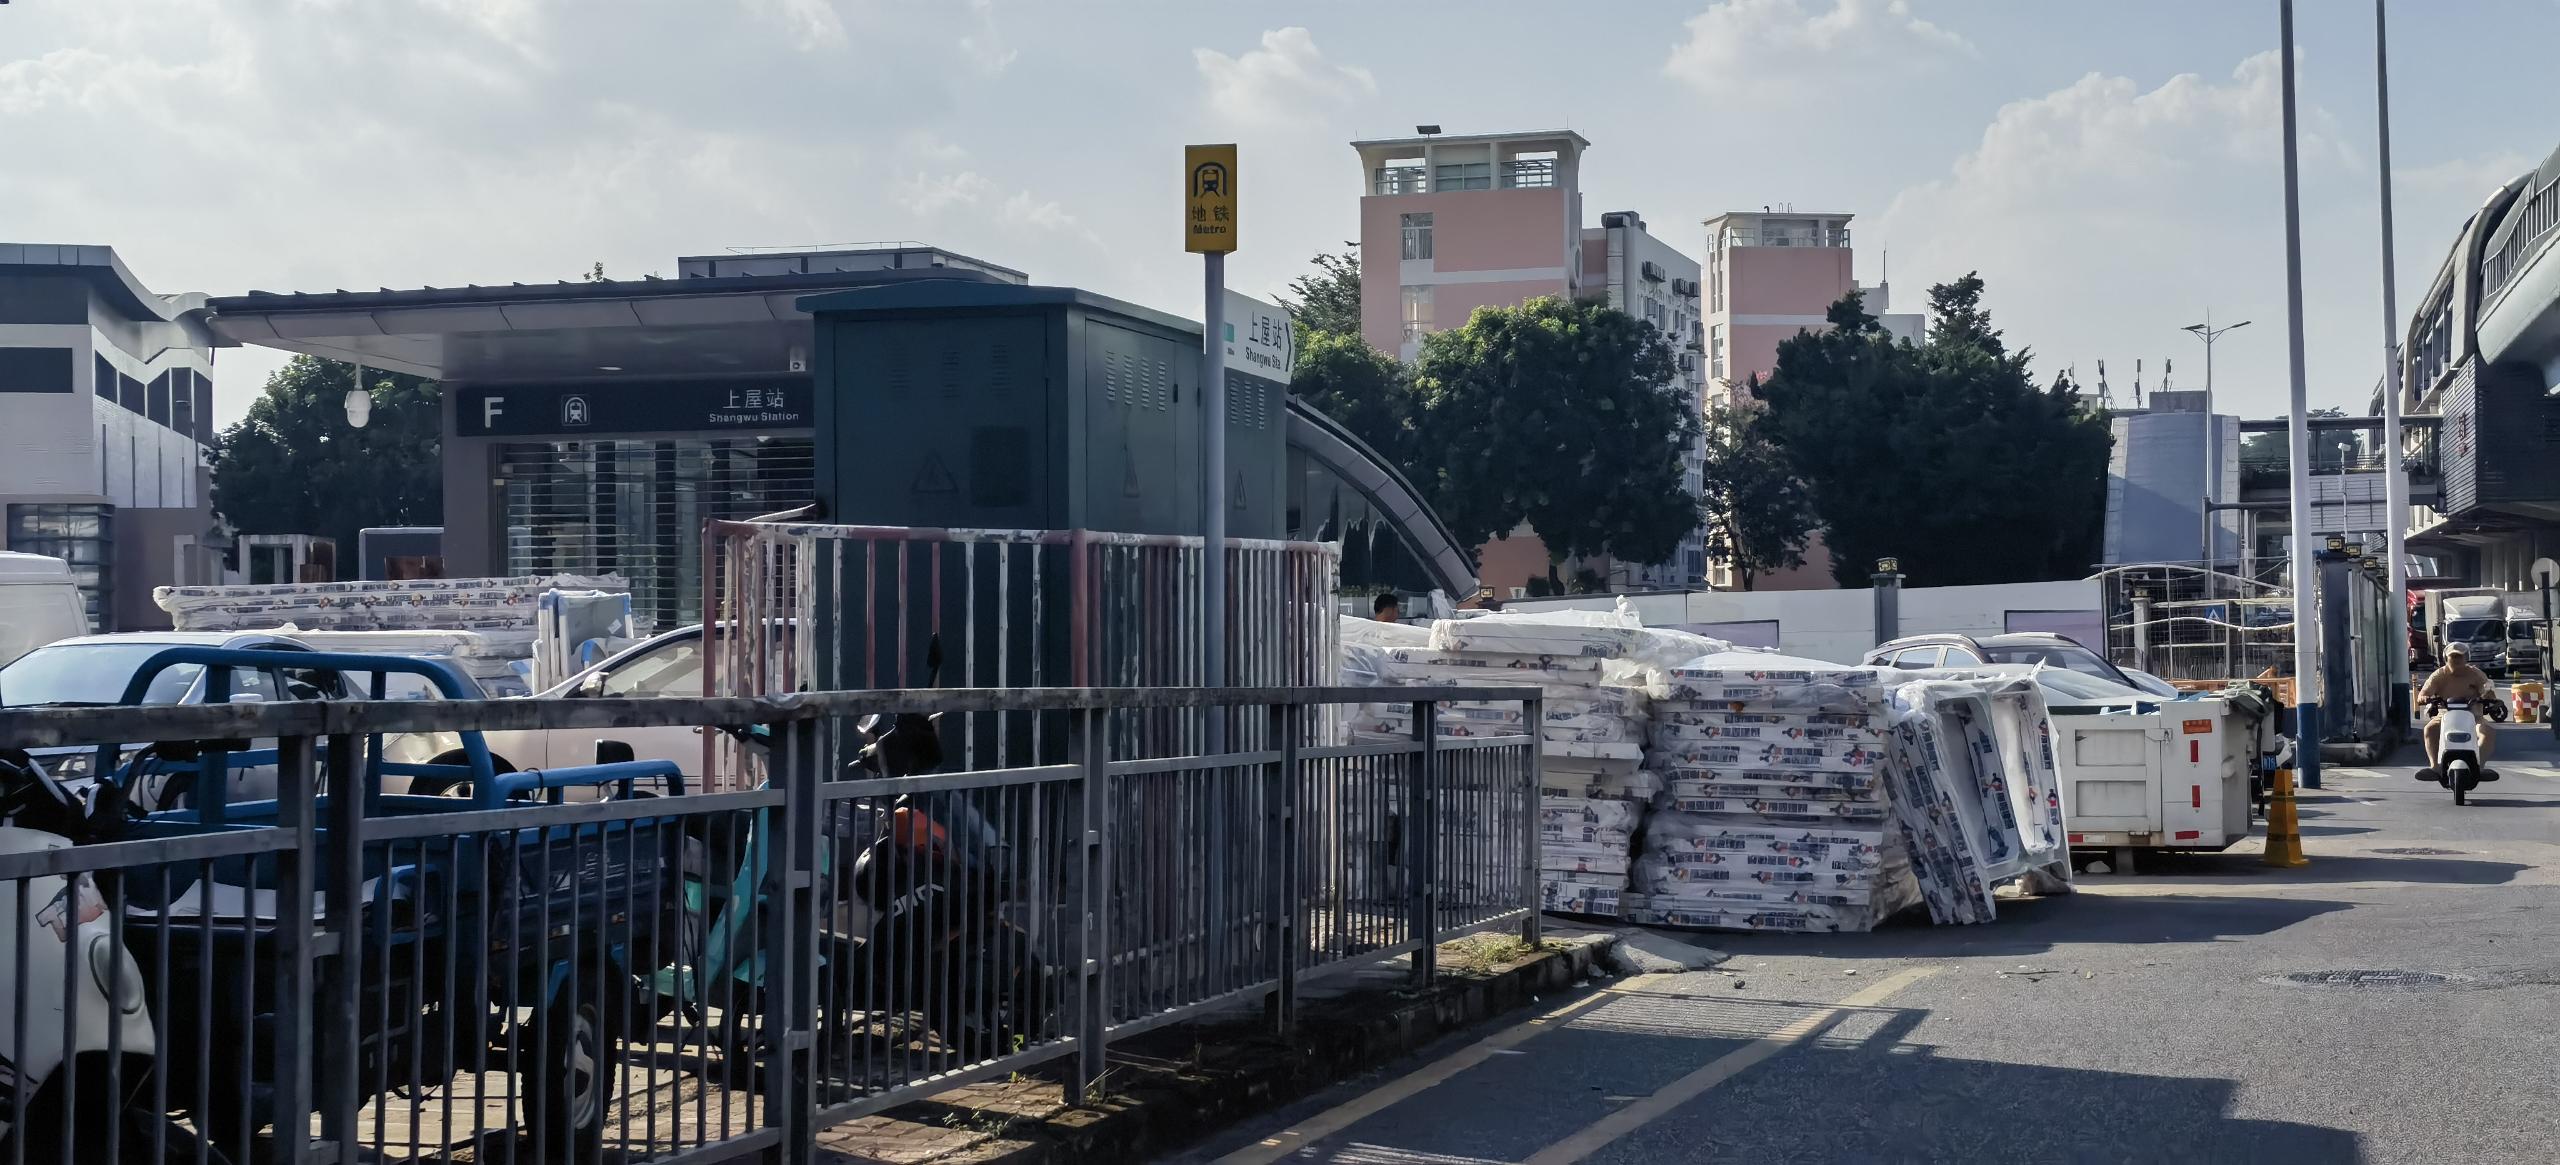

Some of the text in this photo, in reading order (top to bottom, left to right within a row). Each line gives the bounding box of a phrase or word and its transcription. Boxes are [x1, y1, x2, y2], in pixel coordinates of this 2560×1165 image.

[1191, 203, 1230, 222] 地铁
[1193, 224, 1227, 234] Metro
[1248, 311, 1283, 352] 上屋站
[1245, 346, 1271, 369] Shangwu
[1271, 354, 1281, 370] Sta
[722, 387, 784, 409] 上屋站
[484, 396, 505, 429] F
[709, 411, 799, 424] Shangwu Station
